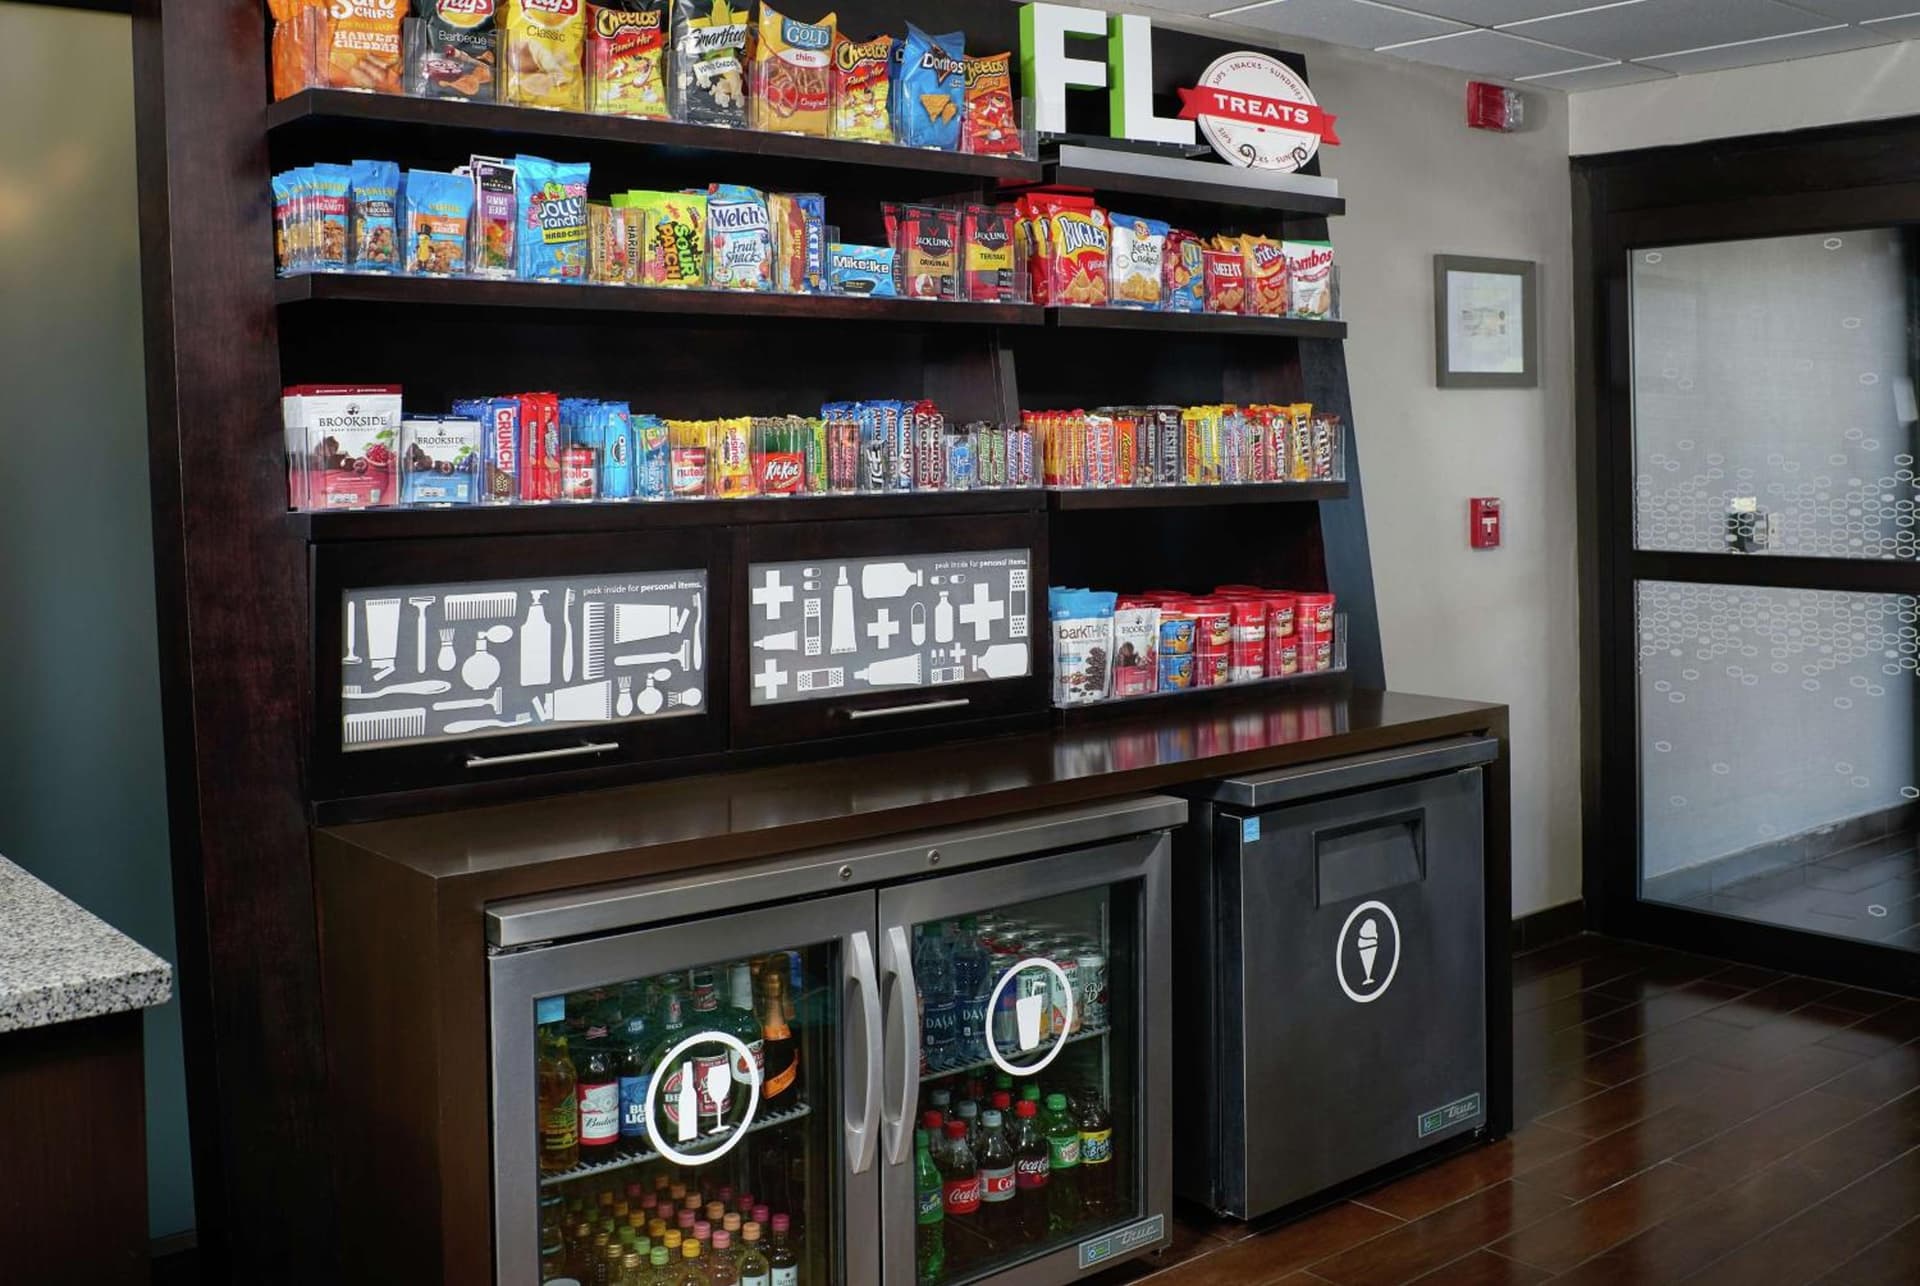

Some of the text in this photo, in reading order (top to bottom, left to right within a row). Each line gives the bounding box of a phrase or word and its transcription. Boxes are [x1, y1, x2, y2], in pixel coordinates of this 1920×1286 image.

[354, 7, 395, 18] CHIPS
[442, 0, 488, 14] Lays
[525, 0, 575, 14] Lays
[526, 25, 565, 42] Classic
[597, 10, 659, 37] Cheetos
[438, 30, 487, 45] Barbecue
[786, 26, 829, 46] GOLD
[837, 41, 889, 72] Cheetos
[922, 52, 964, 74] Doritos
[1212, 70, 1227, 85] SIPS
[1230, 61, 1262, 72] SNACKS
[1213, 93, 1310, 124] TREATS
[540, 197, 584, 219] JOLLY
[711, 206, 767, 228] Welch's
[656, 222, 683, 280] PATCH
[674, 224, 699, 277] SOUR
[319, 415, 388, 428] BROOKSIDE
[416, 436, 465, 446] BROOKSIDE
[497, 410, 513, 471] CRUNCH
[931, 413, 943, 483] Mounds
[583, 588, 601, 597] peek
[603, 585, 626, 594] inside
[640, 581, 676, 593] personal
[625, 1112, 646, 1124] LIG
[629, 1103, 646, 1115] BU
